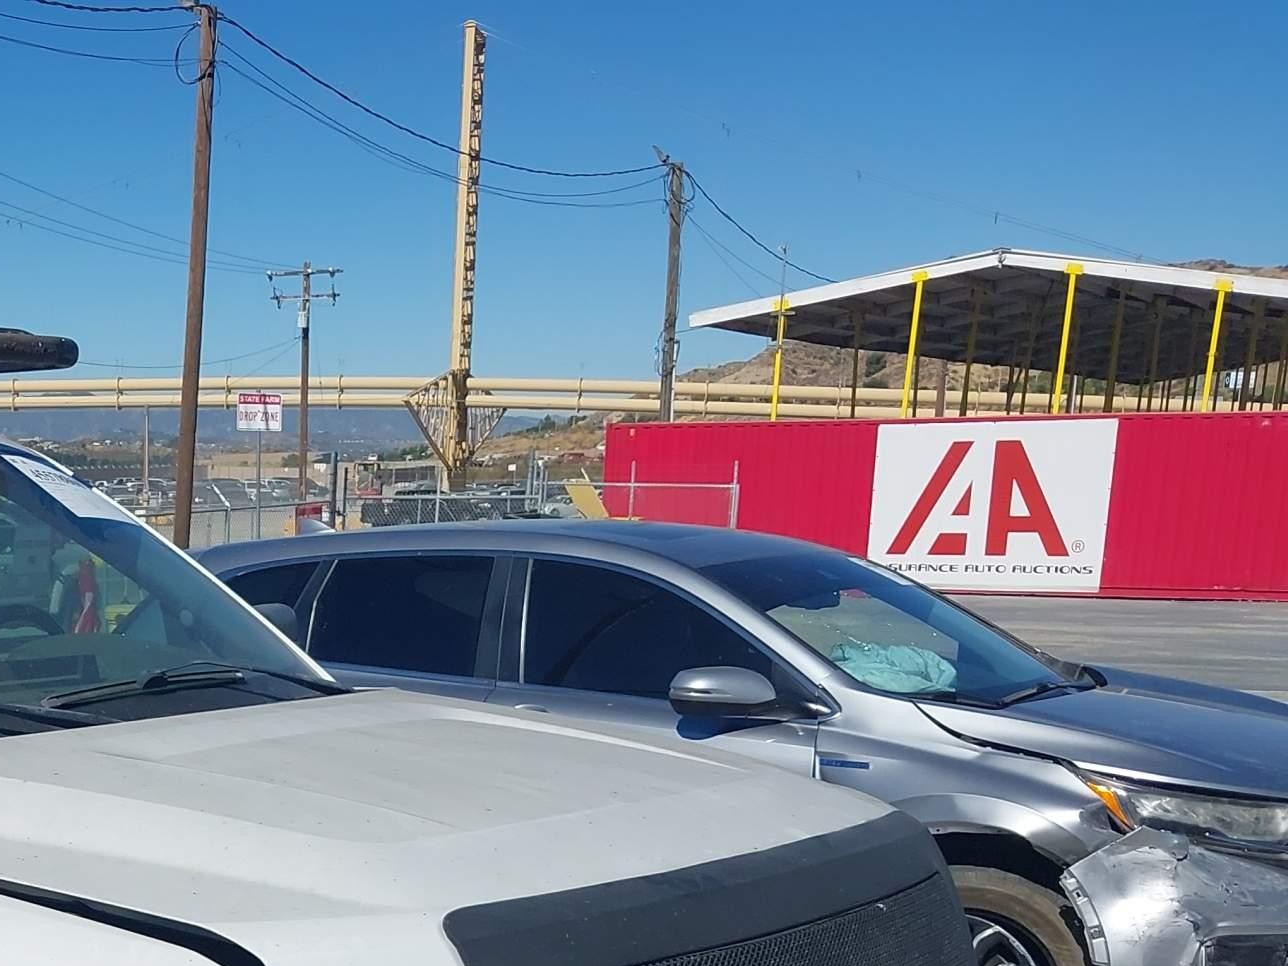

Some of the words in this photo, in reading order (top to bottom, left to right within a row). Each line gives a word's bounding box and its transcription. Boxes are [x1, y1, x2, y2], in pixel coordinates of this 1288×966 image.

[239, 410, 257, 421] DROP
[887, 563, 960, 573] SURANCE
[964, 564, 1007, 573] AUTO
[1012, 564, 1094, 574] AUCTIONS
